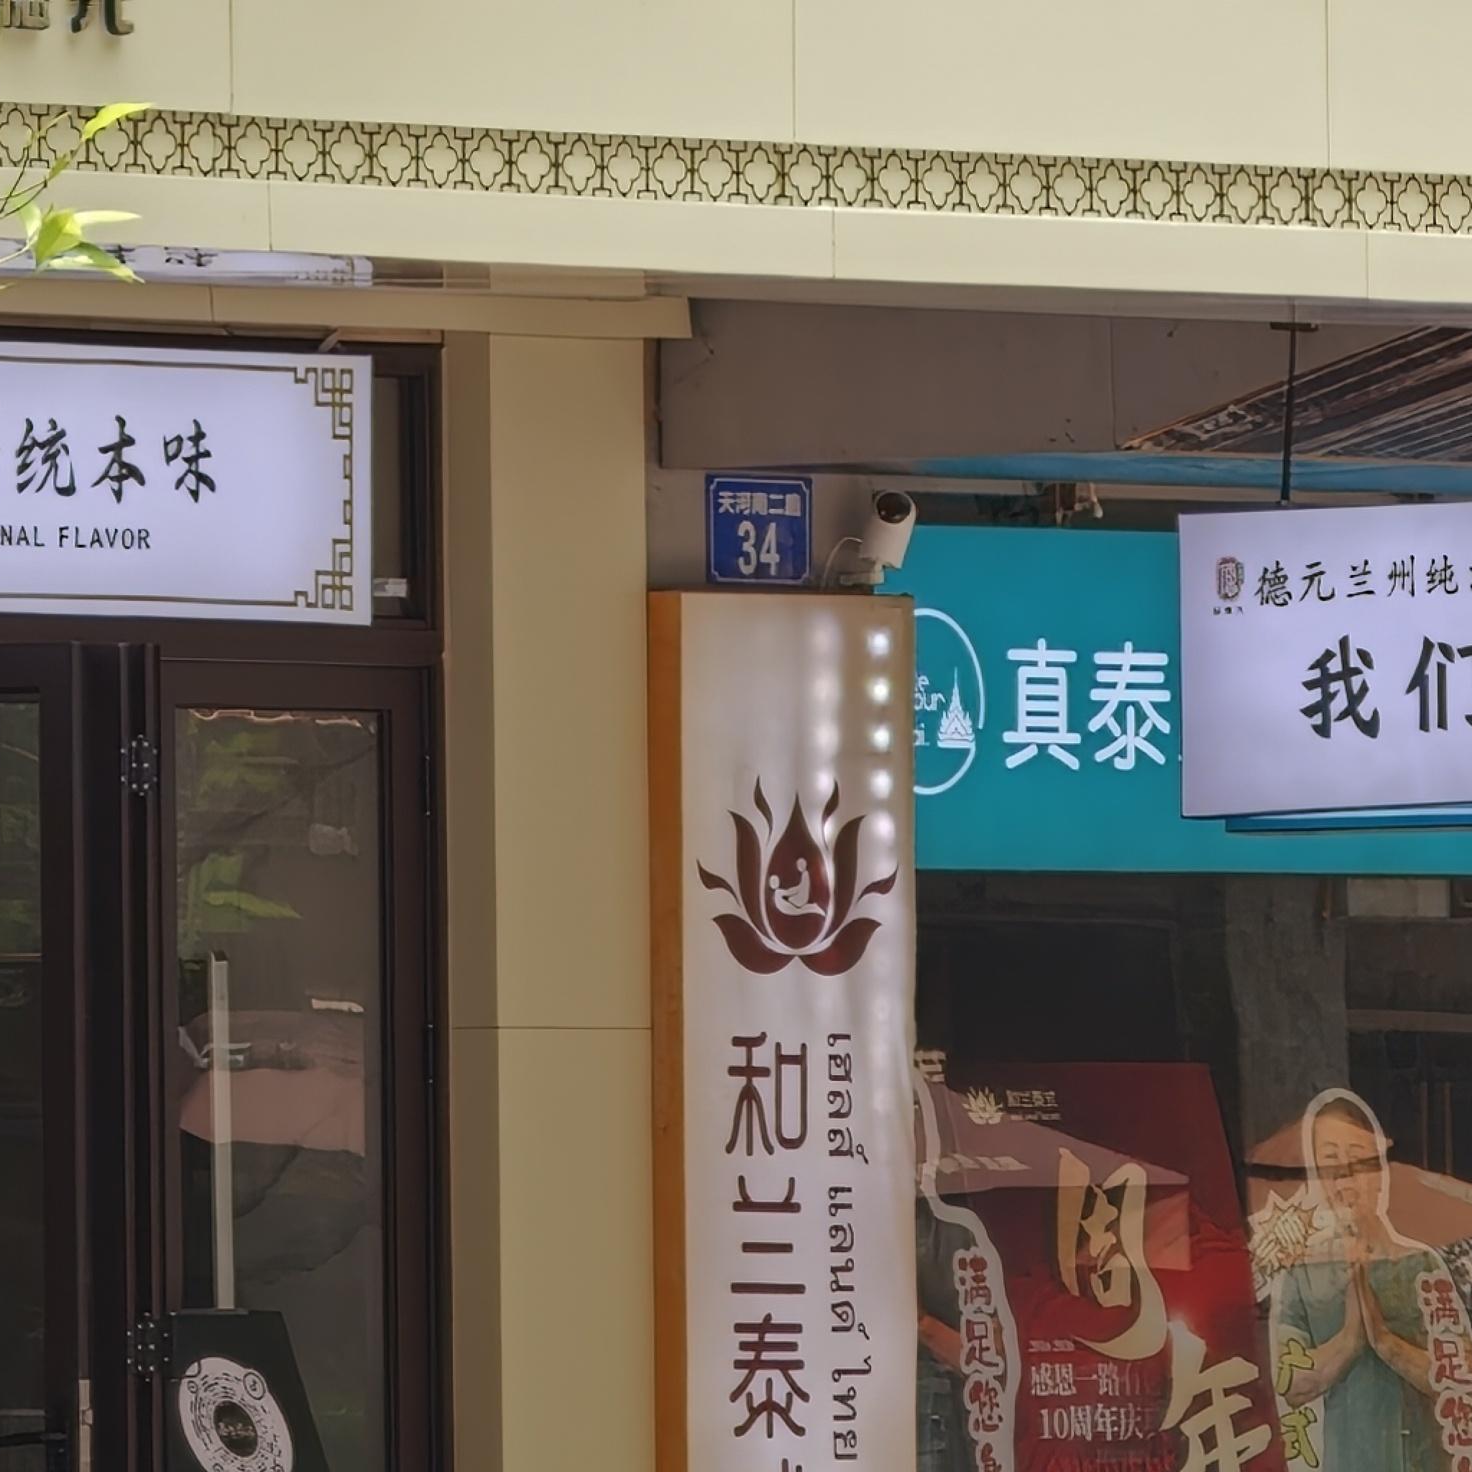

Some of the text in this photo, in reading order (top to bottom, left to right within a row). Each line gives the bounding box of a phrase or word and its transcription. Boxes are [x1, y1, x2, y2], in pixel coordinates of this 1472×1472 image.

[57, 526, 152, 550] FLAVOR
[737, 520, 781, 576] 34
[1002, 637, 1172, 771] 真泰
[831, 1357, 873, 1462] ไทย
